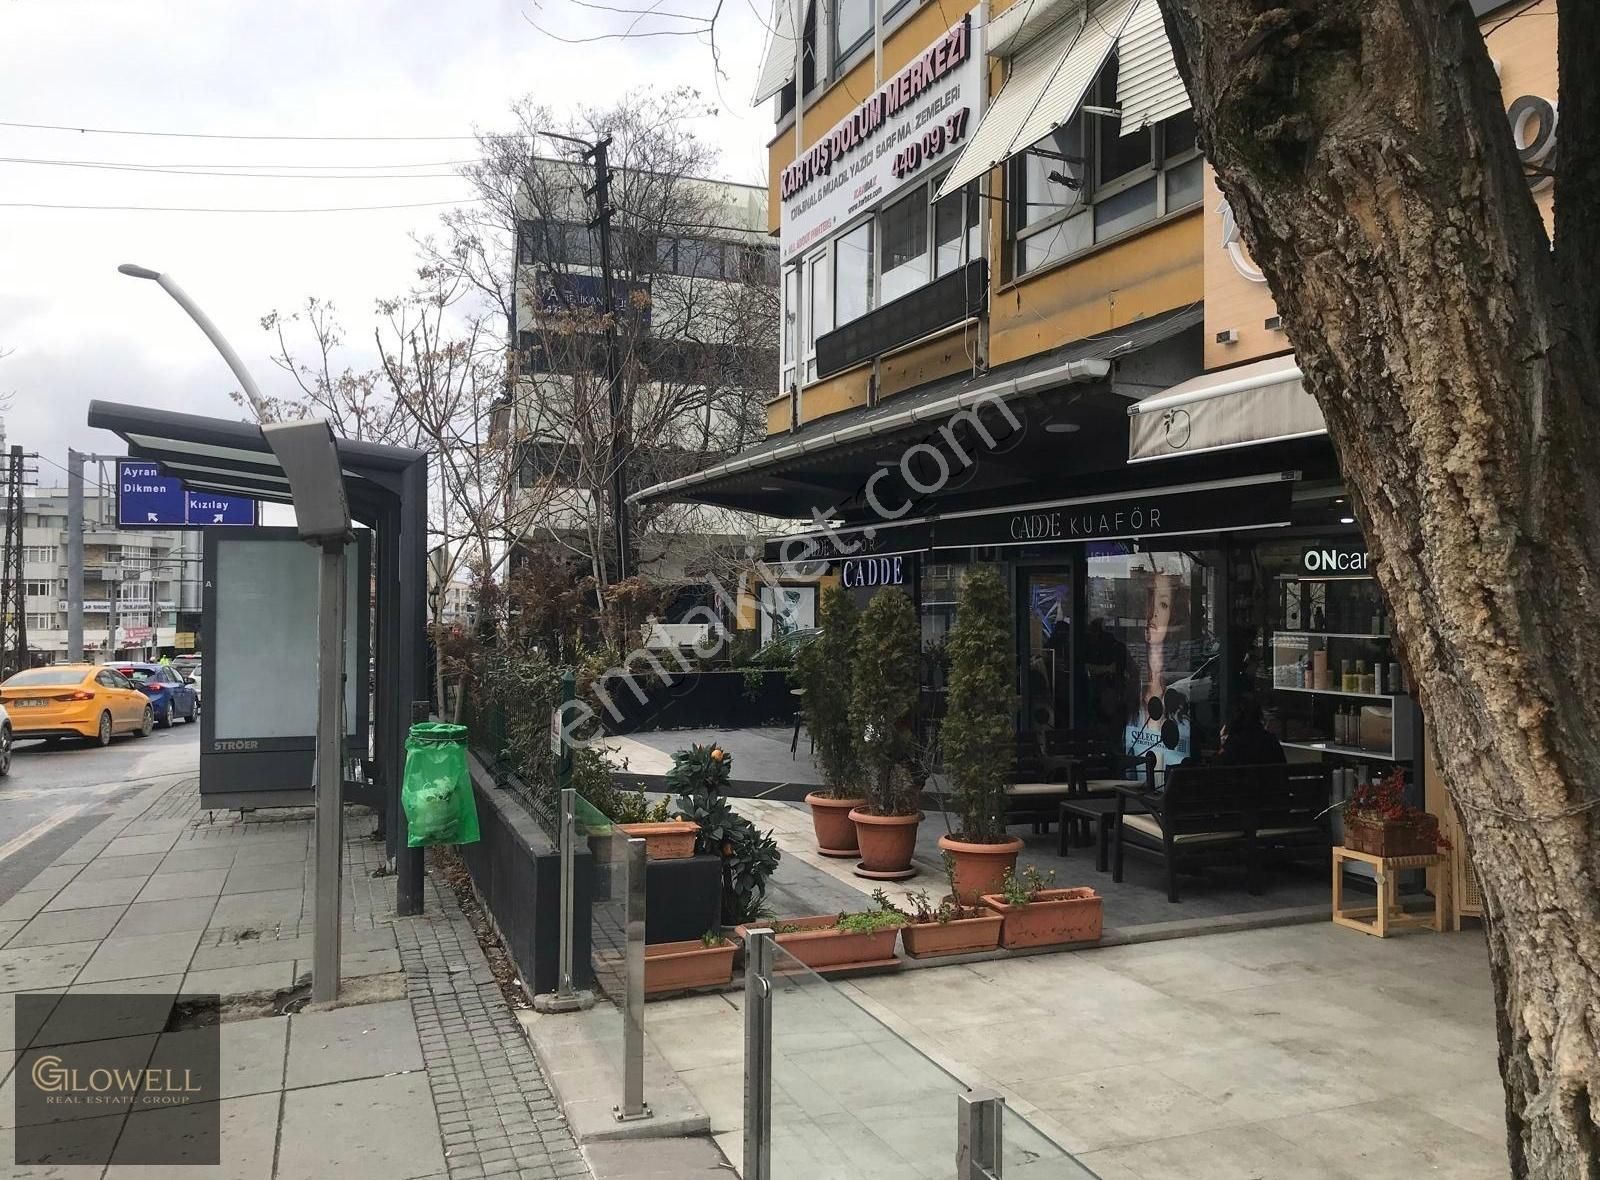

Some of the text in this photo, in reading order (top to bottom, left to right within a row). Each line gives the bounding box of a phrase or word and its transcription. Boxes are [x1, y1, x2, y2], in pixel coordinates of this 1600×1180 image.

[780, 15, 970, 201] KARTUŞ DOLUM MERKEZİ
[891, 108, 968, 178] 440 09 37
[124, 484, 167, 493] Dikmen
[190, 500, 229, 510] Kızılay
[1010, 507, 1161, 540] CADDE KUAFÖR
[843, 556, 903, 588] CADDE
